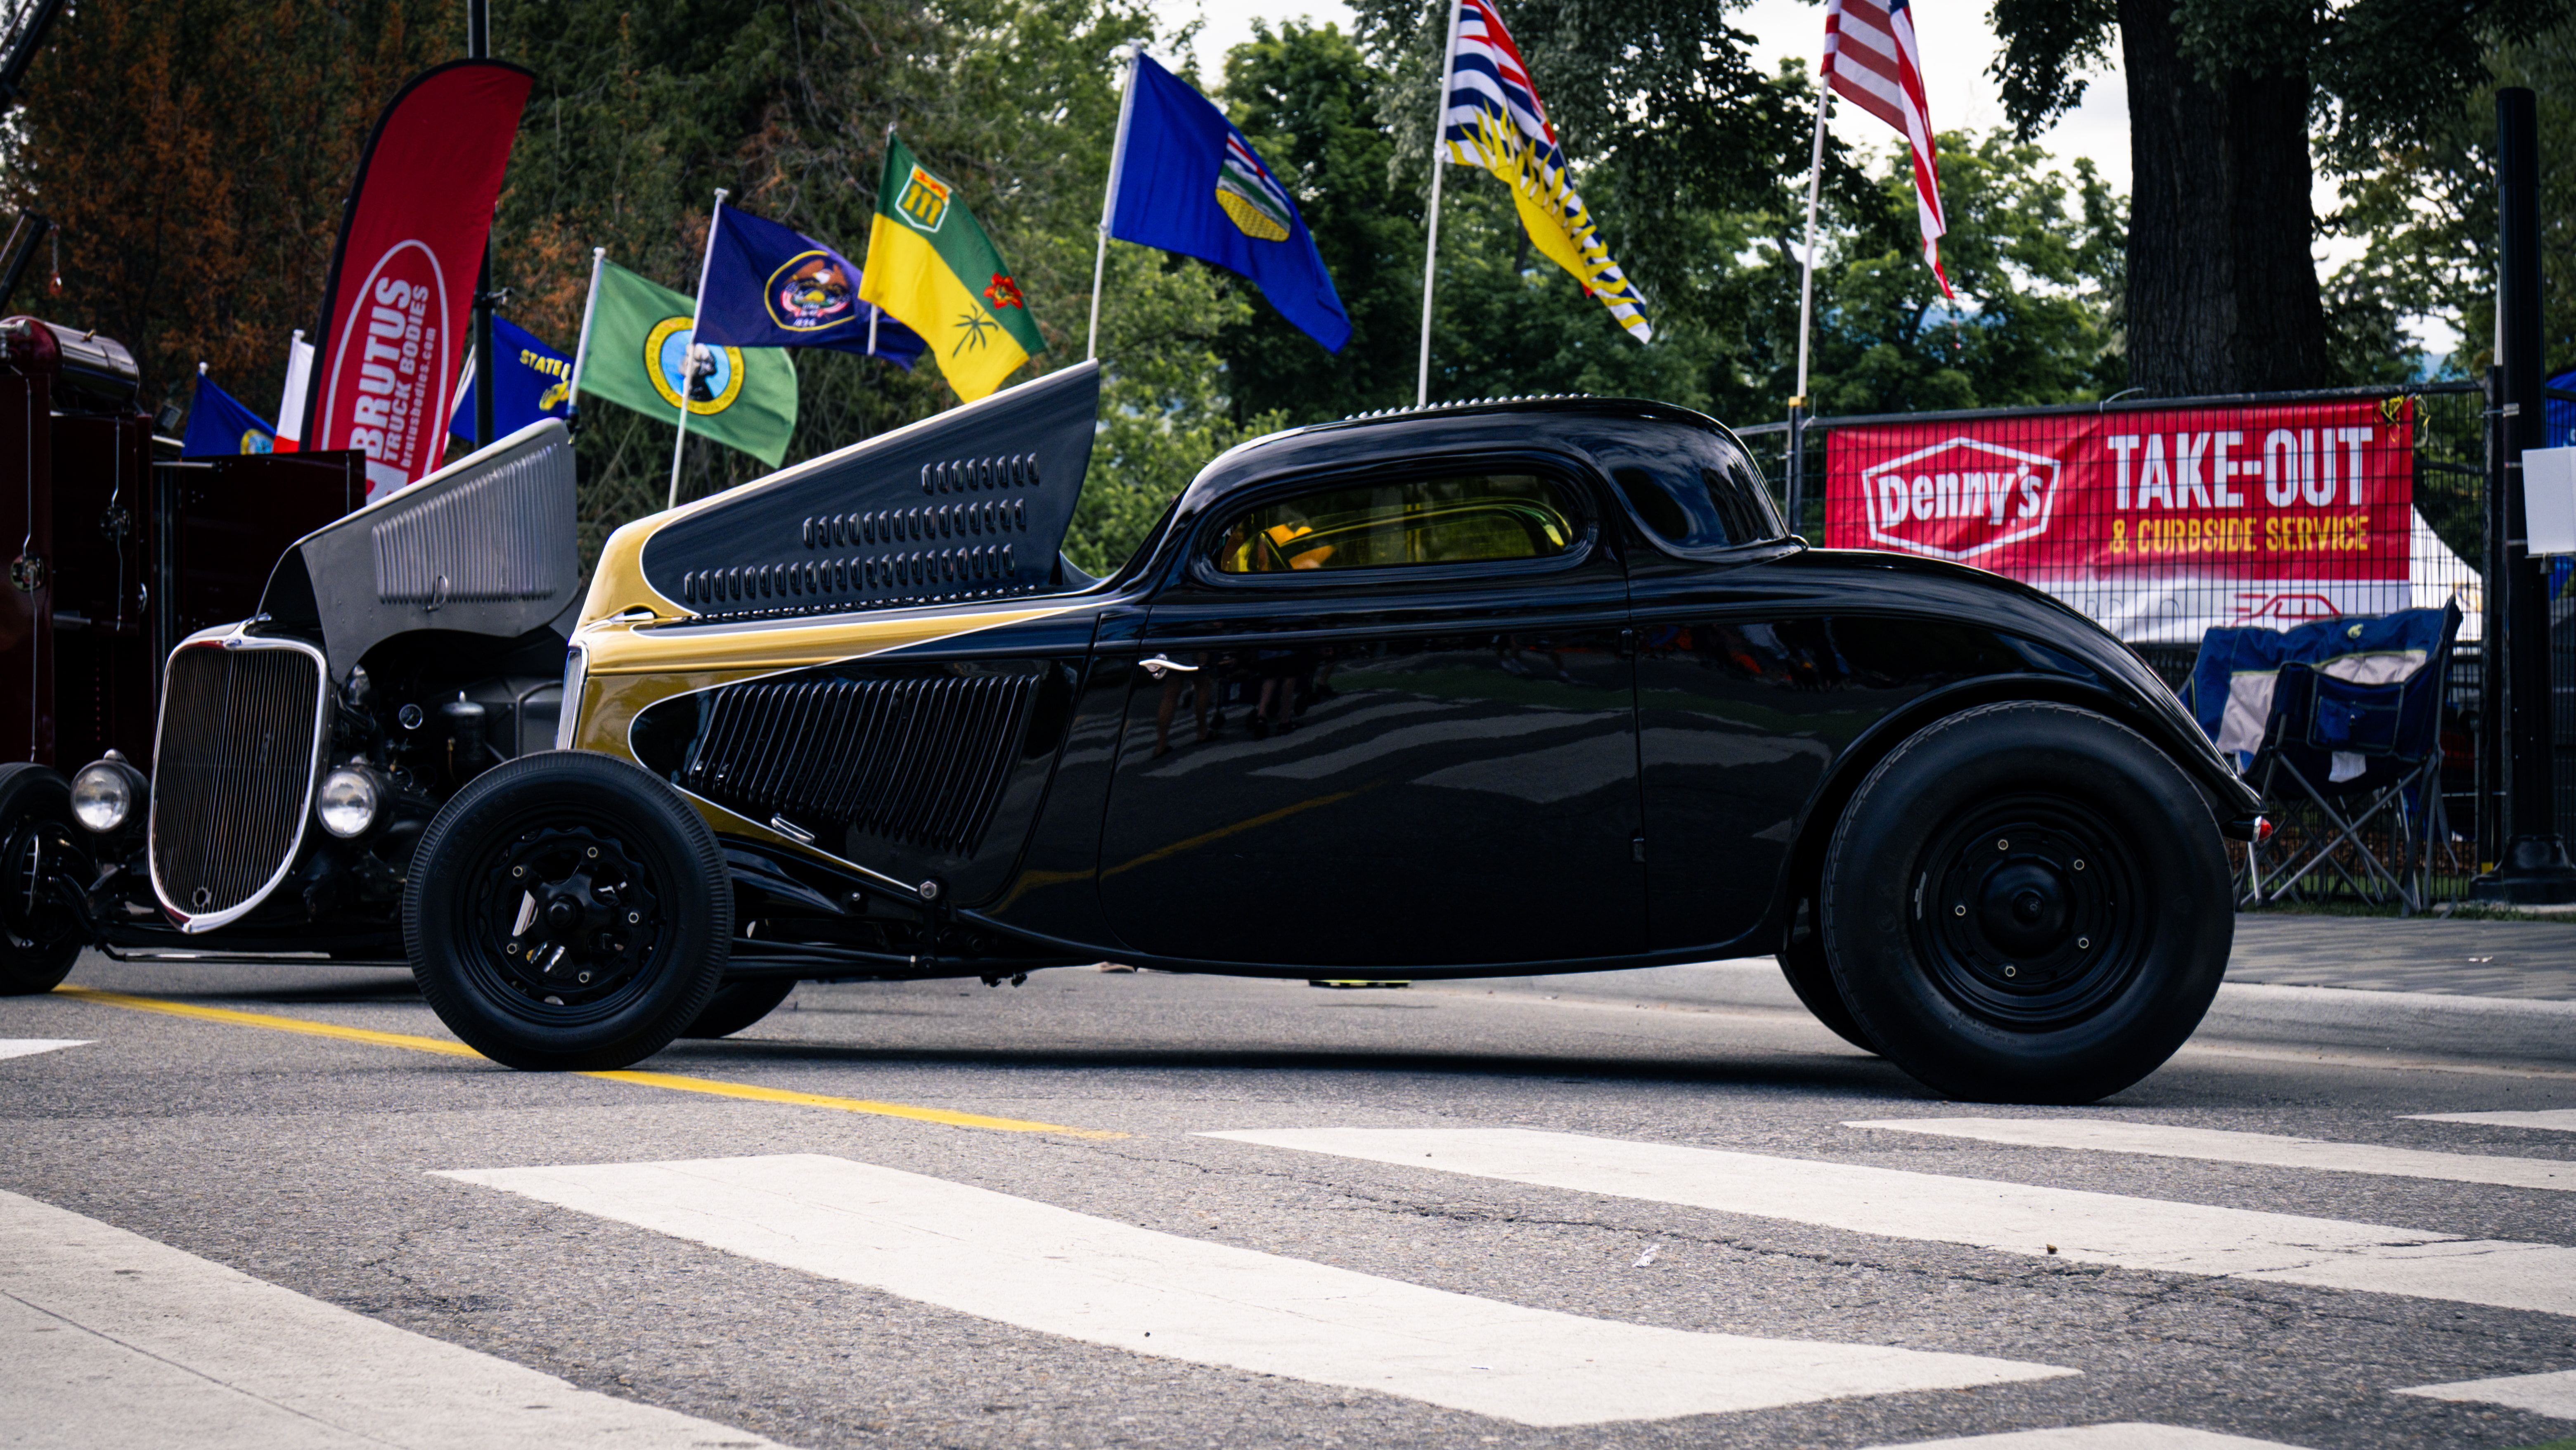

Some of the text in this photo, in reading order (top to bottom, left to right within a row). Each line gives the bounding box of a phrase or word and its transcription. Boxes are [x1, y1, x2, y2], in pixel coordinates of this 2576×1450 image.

[349, 277, 412, 460] BRUTUS
[383, 285, 429, 462] TRUCK BODIES
[400, 327, 436, 469] brutusbodies.com
[519, 349, 563, 376] STATE
[1878, 462, 2043, 528] Denny's
[2107, 427, 2373, 509] TAKE-OUT
[2110, 516, 2369, 553] & CURBSIDE SERVICE
